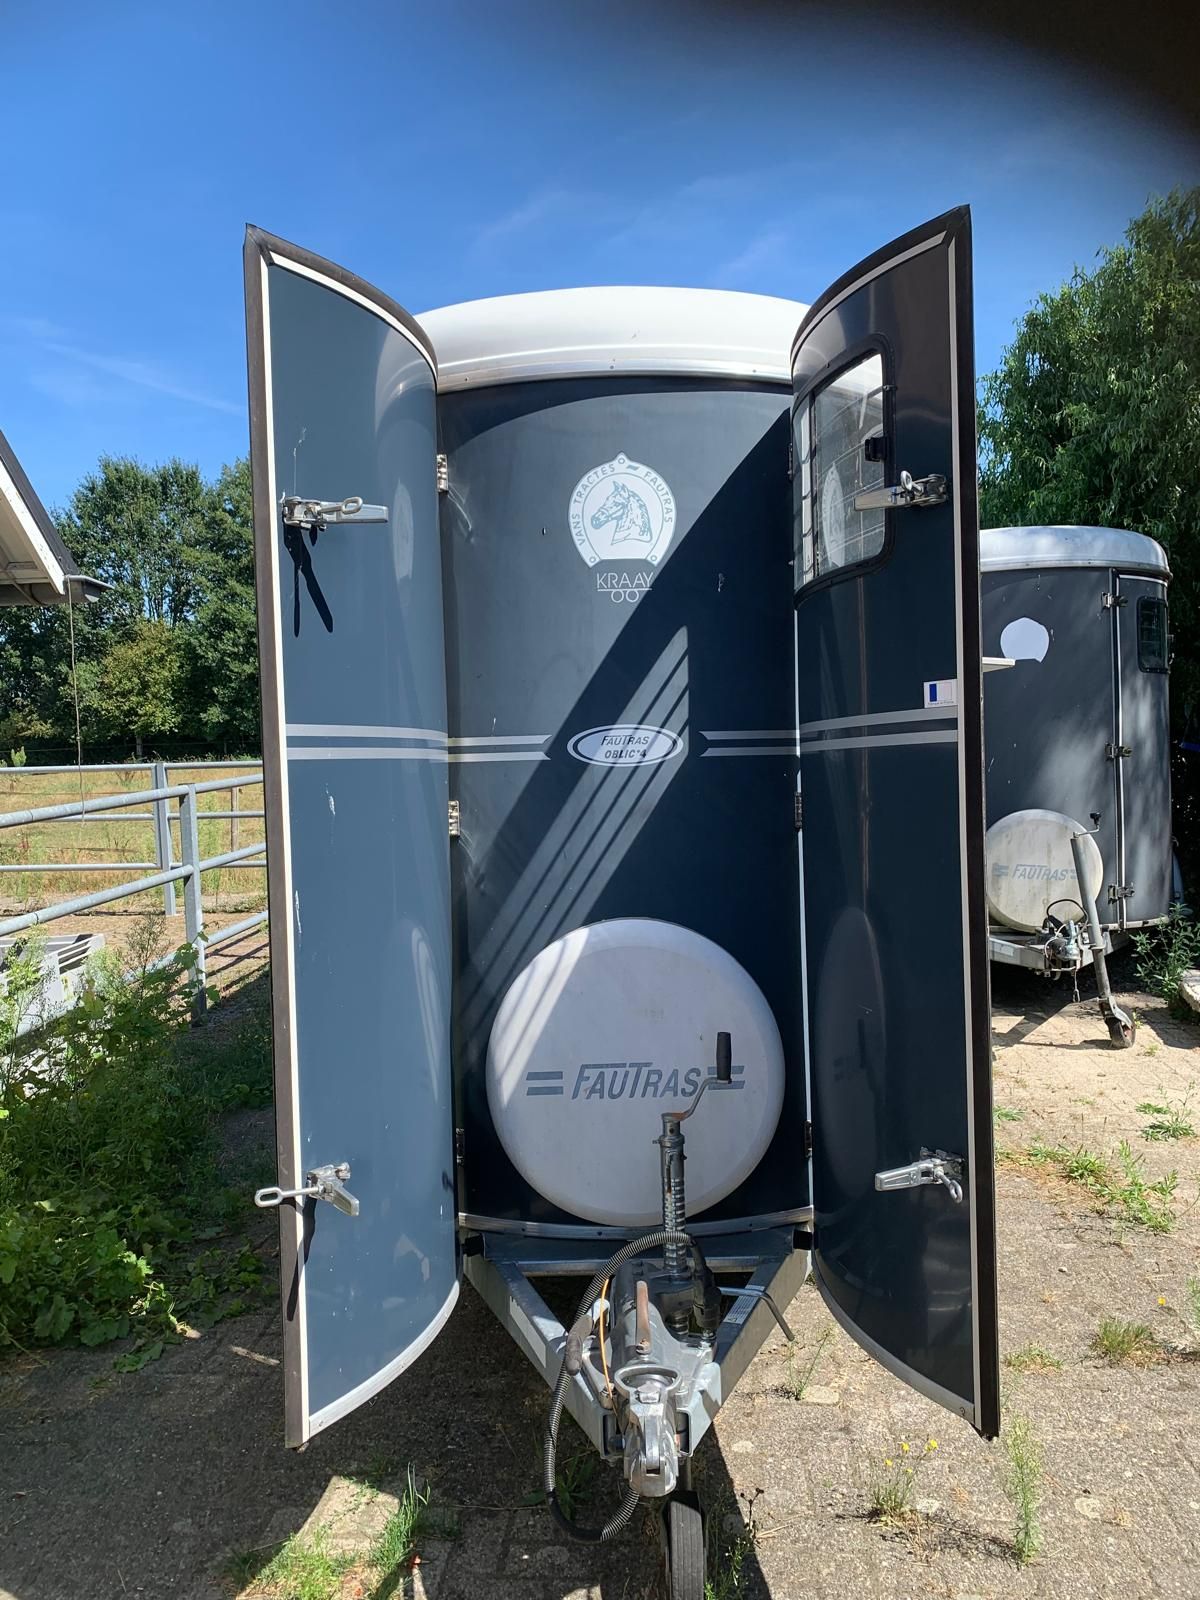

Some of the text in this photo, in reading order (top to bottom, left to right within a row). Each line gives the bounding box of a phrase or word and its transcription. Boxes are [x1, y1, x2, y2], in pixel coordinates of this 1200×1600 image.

[571, 463, 673, 546] VANS TRACTES FAUTRAS
[596, 571, 654, 589] KRAAY
[600, 734, 650, 746] FAUTRAS
[1012, 863, 1068, 881] FAUTRAS
[571, 1062, 701, 1100] FAUTRAS
